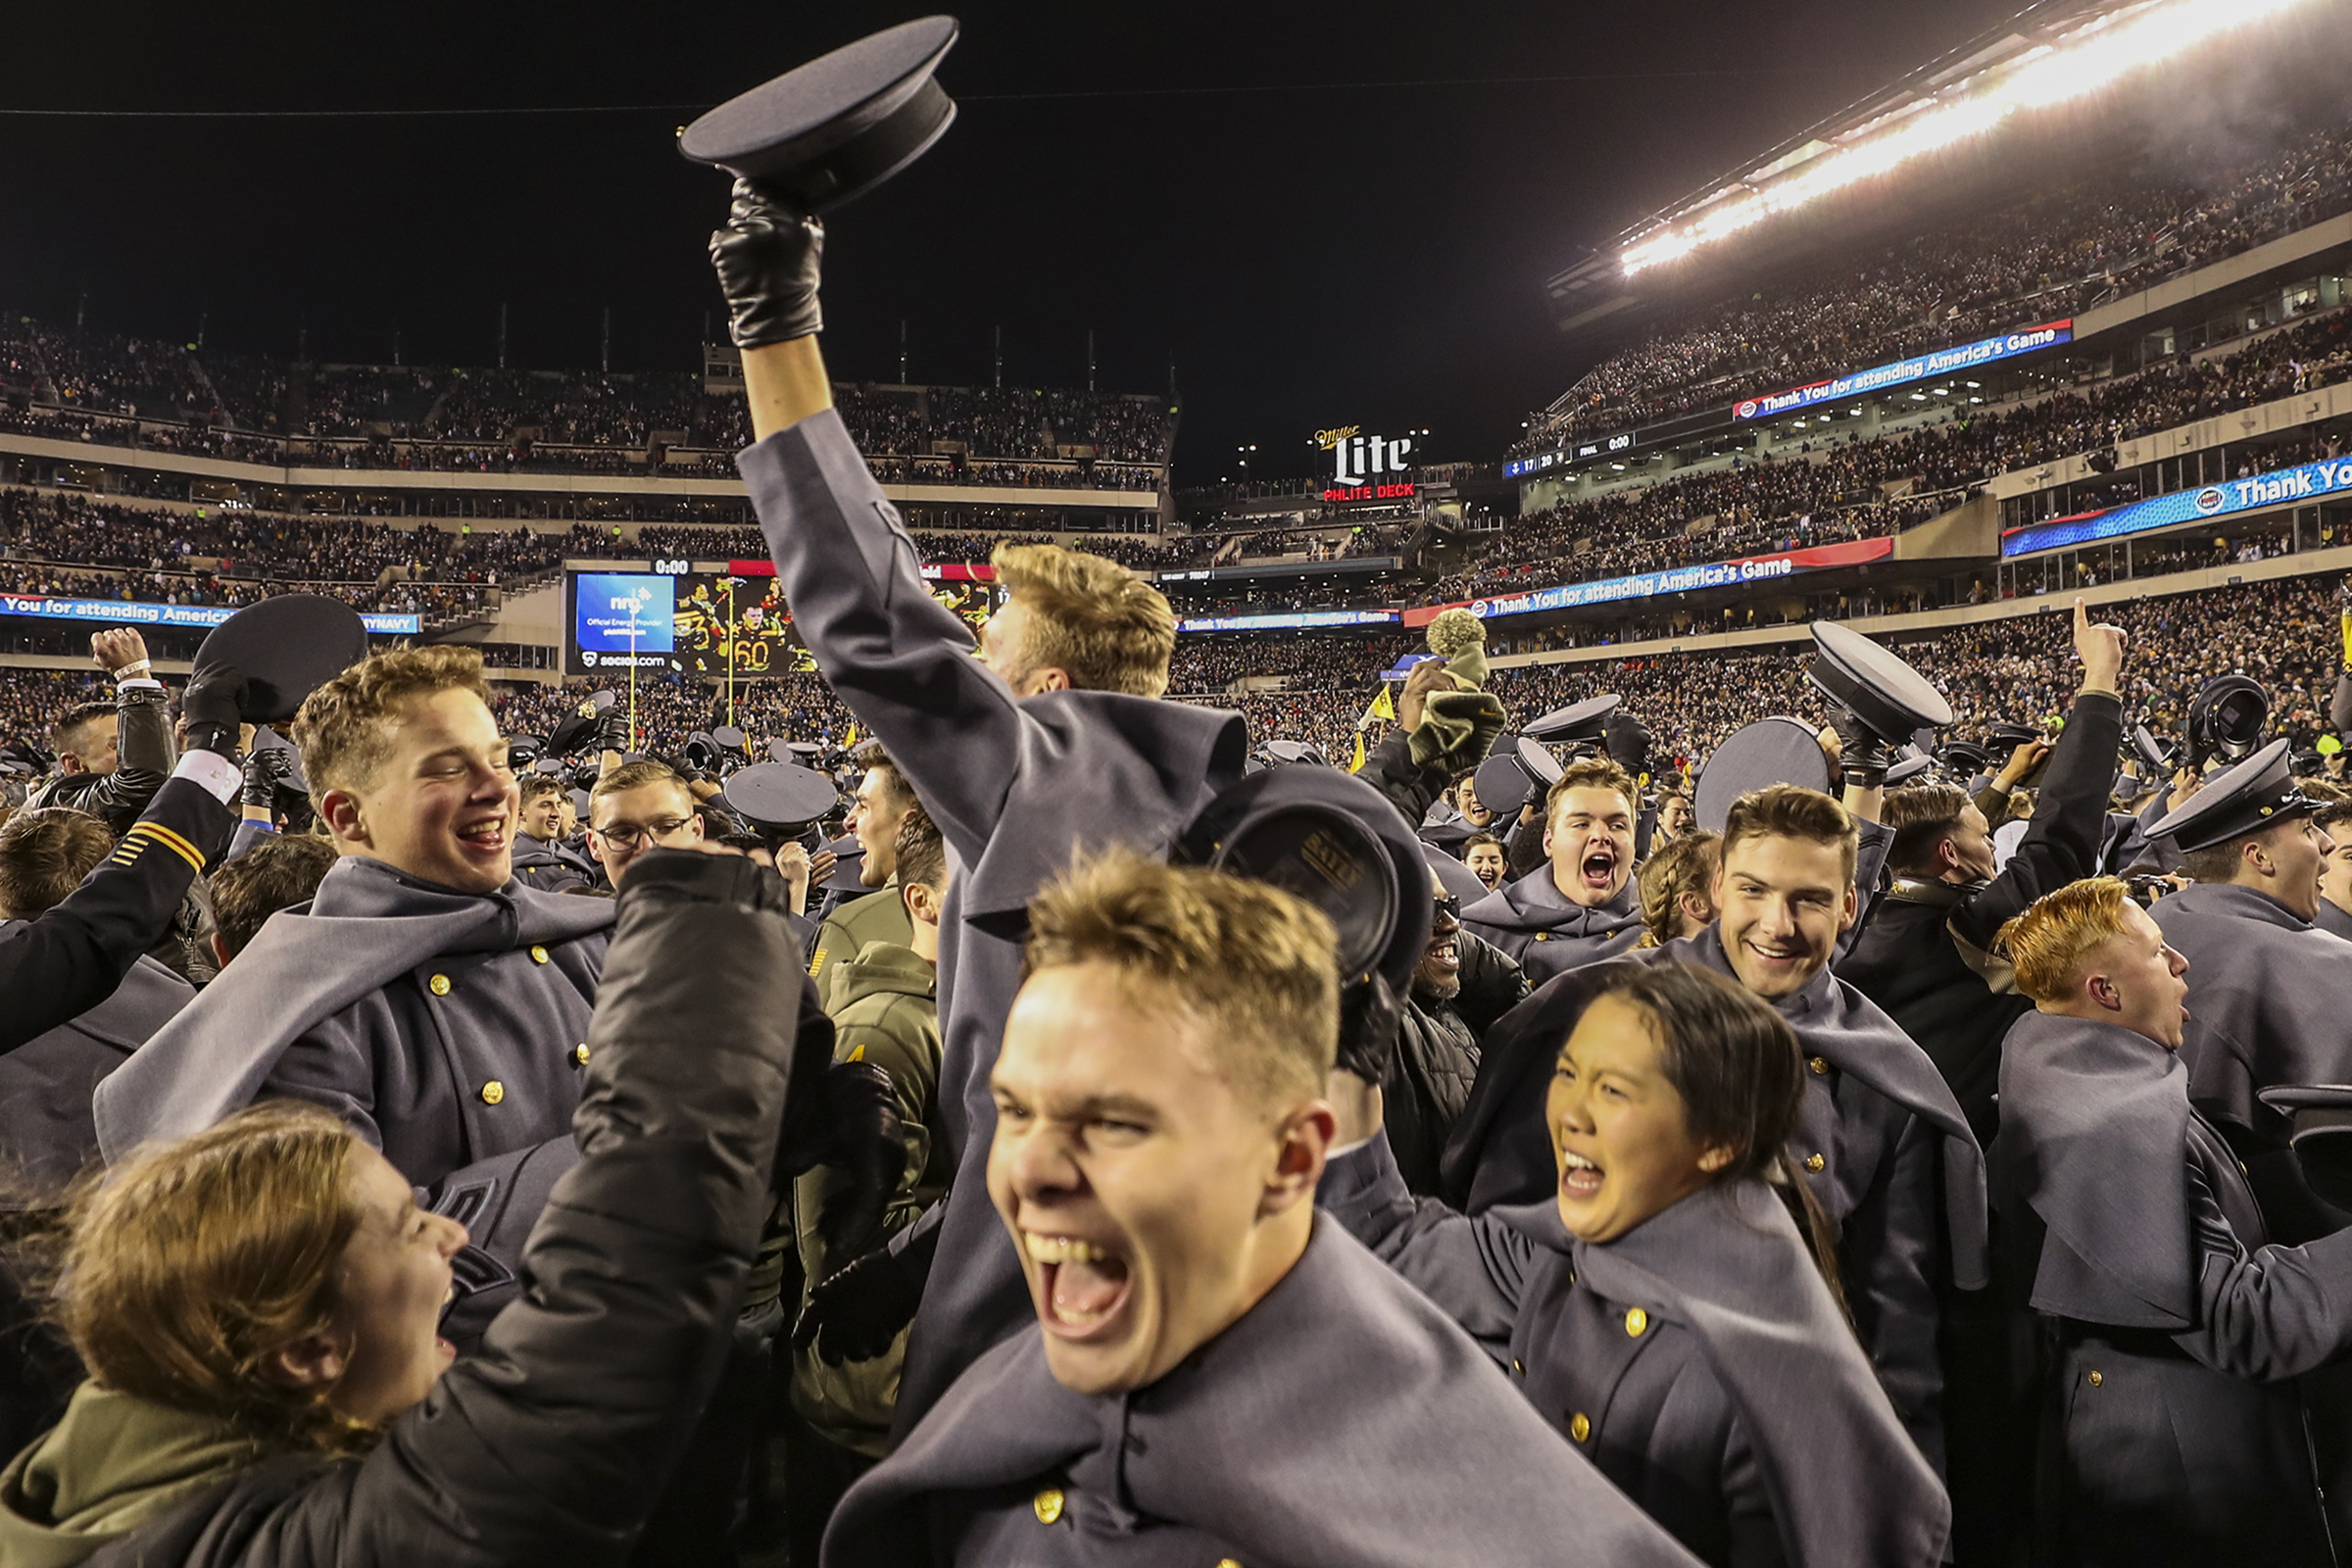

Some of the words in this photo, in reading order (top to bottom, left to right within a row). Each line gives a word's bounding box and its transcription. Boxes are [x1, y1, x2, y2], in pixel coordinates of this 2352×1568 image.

[1762, 390, 1801, 412] Thank
[1803, 384, 1830, 401] You
[1832, 379, 1852, 393] for
[1855, 362, 1924, 389] attending
[1927, 341, 2004, 371] America's
[2007, 329, 2055, 351] Game
[1314, 425, 1360, 450] Miller
[1580, 446, 1597, 457] FINAL
[1609, 435, 1630, 450] 0:00
[1334, 435, 1411, 486] Lite
[1524, 460, 1534, 470] 17
[1541, 455, 1552, 467] 20
[1323, 486, 1372, 502] PHLITE
[1377, 483, 1415, 498] DECK
[2235, 469, 2313, 506] Thank
[2318, 463, 2352, 489] Yo
[656, 559, 689, 574] 0:00
[1493, 599, 1530, 614] Thank
[1532, 593, 1558, 608] You
[1561, 588, 1583, 603] for
[1585, 579, 1654, 601] attending
[1658, 564, 1738, 590] America's
[1740, 559, 1792, 579] Game
[4, 597, 41, 612] You
[46, 599, 72, 613] for
[75, 603, 159, 621] attending
[586, 617, 611, 626] Official
[636, 617, 663, 626] Provider
